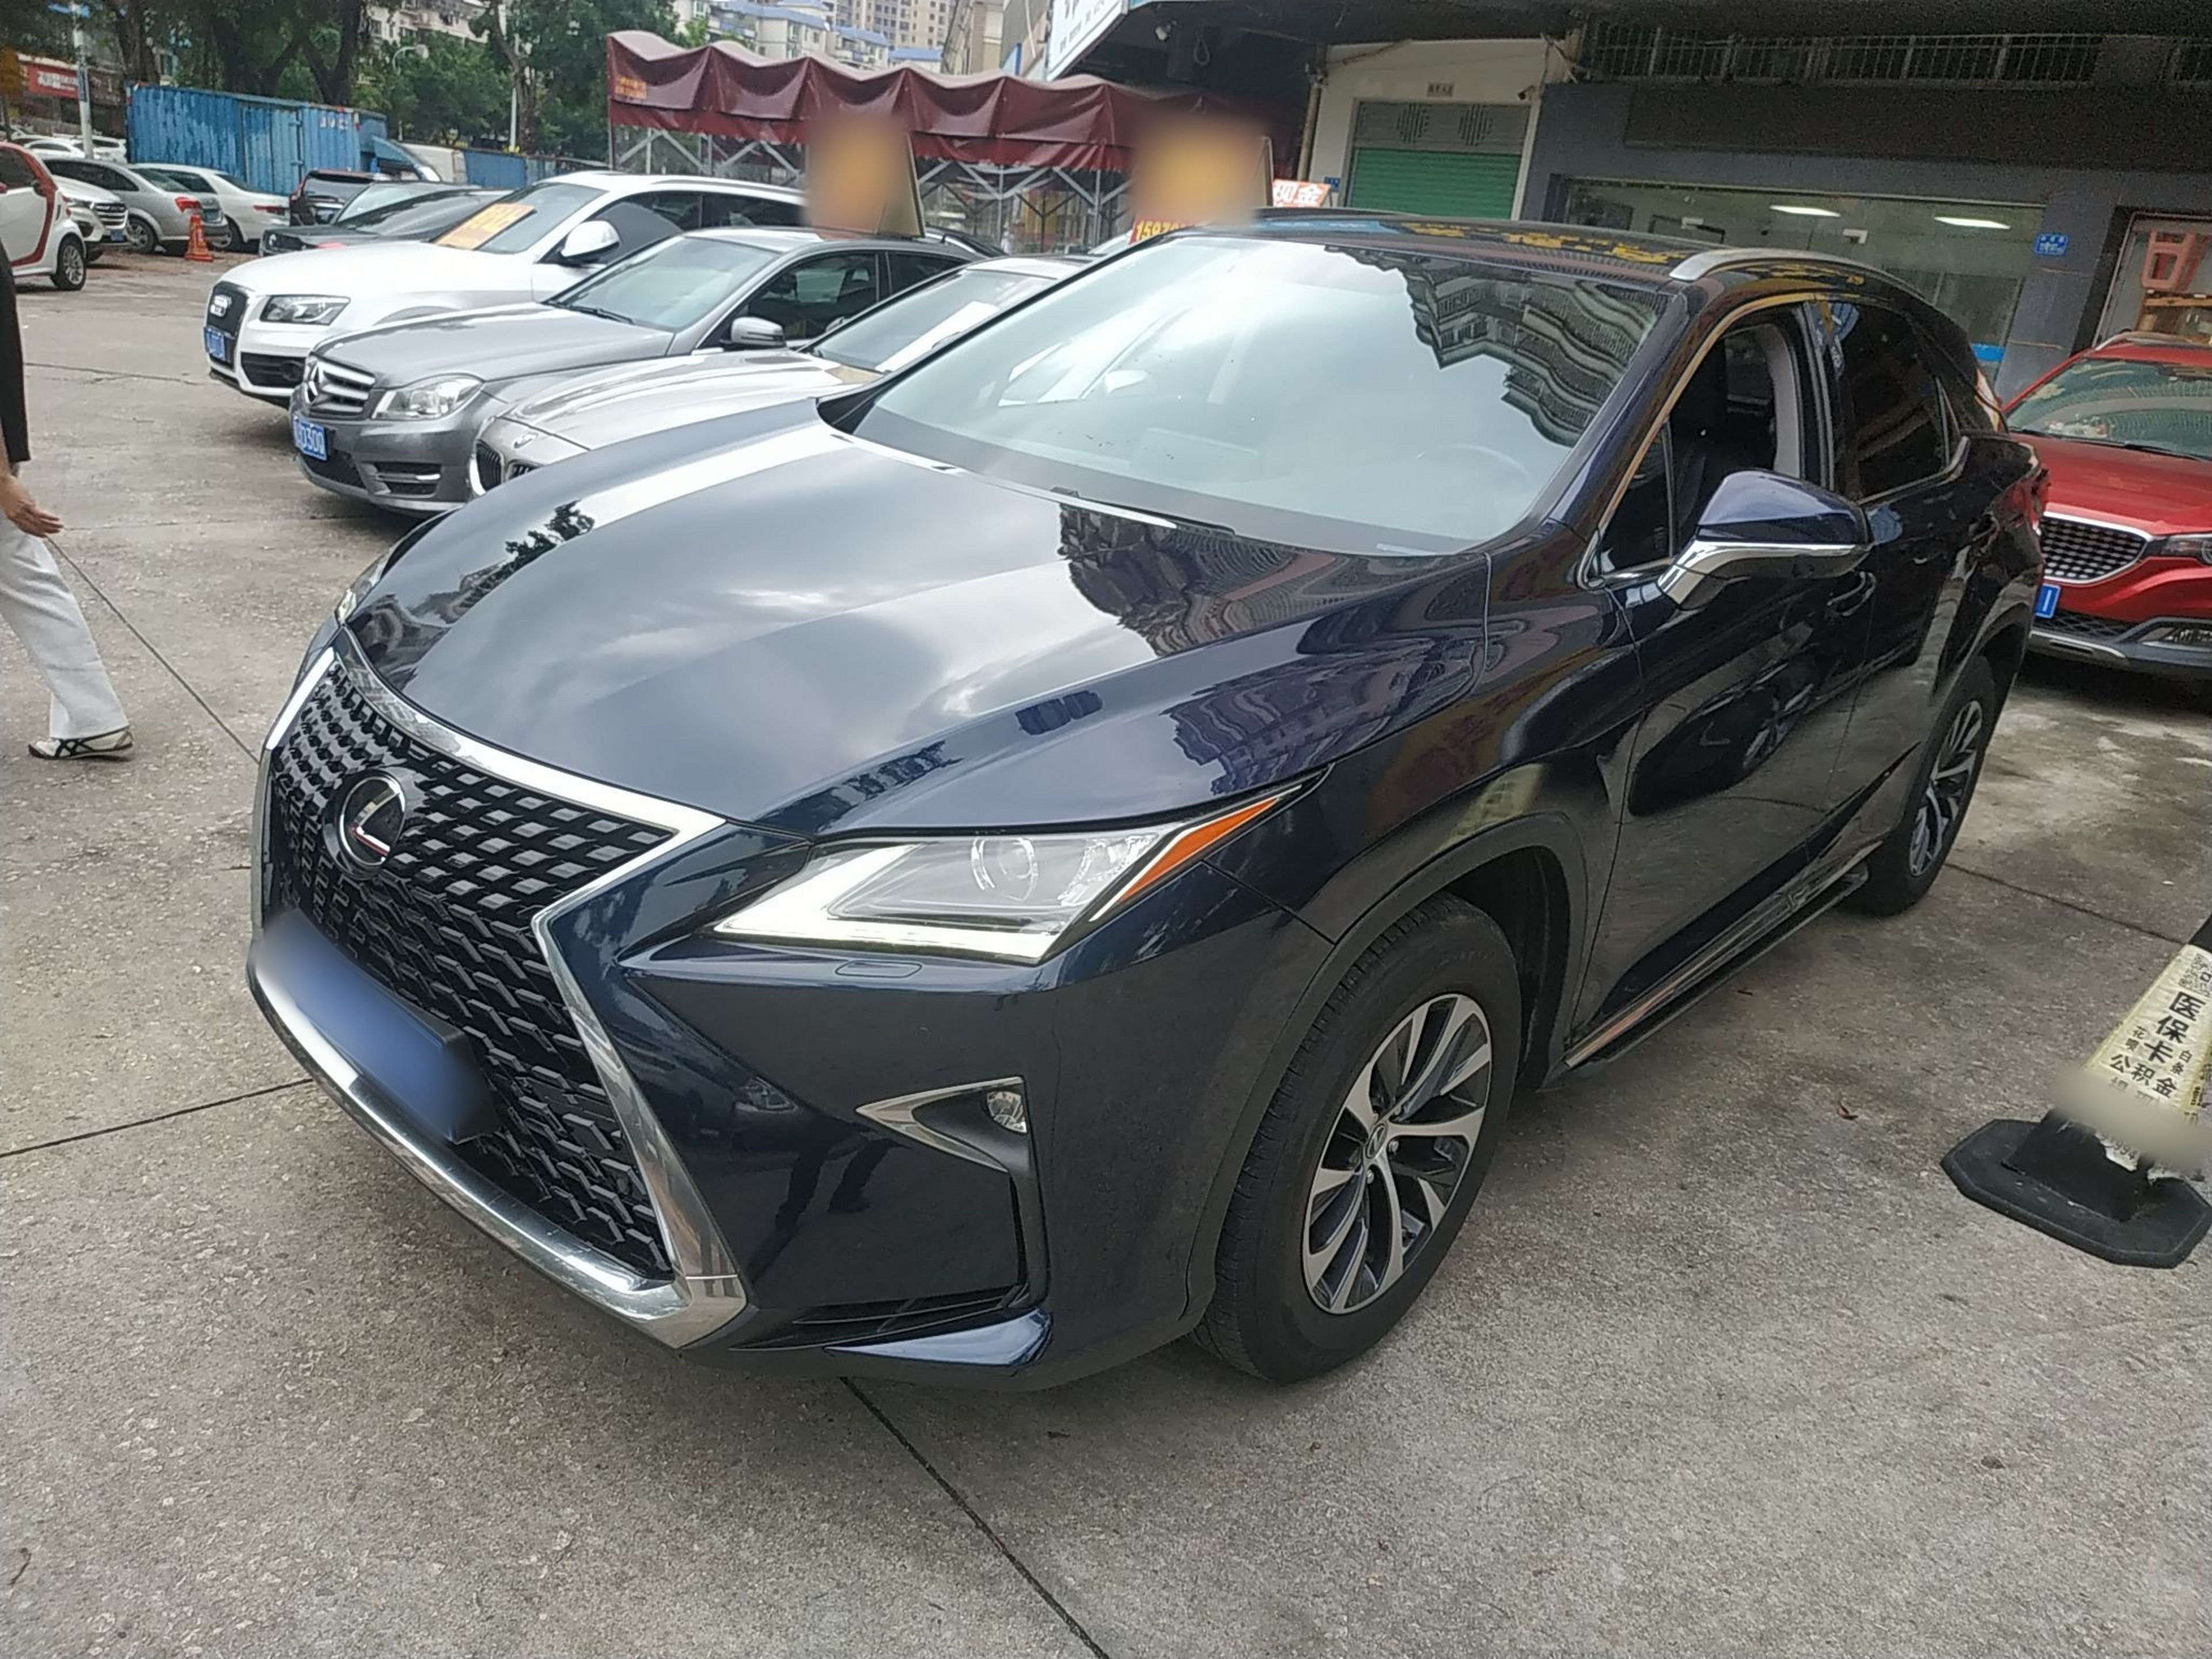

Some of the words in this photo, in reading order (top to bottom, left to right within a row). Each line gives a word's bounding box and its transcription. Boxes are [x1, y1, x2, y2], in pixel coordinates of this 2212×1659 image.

[2144, 991, 2205, 1065] 医保卡
[2110, 1053, 2177, 1099] 公积金
